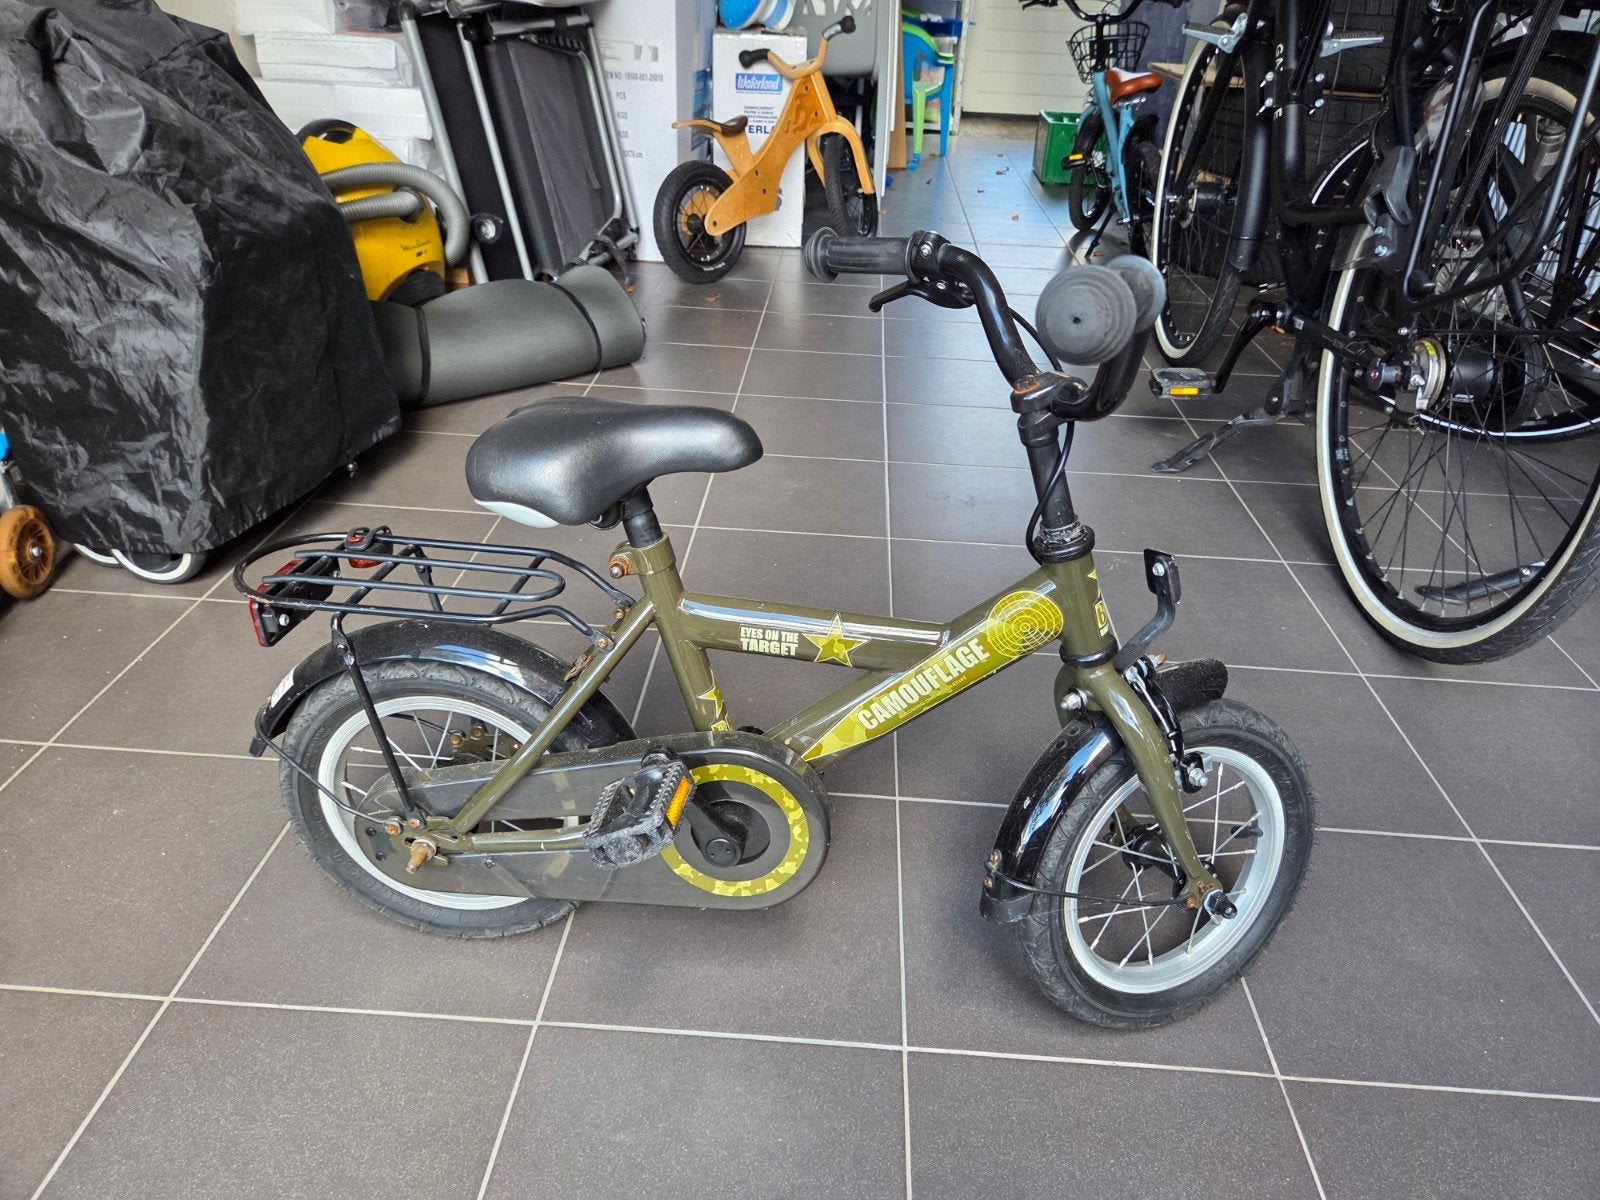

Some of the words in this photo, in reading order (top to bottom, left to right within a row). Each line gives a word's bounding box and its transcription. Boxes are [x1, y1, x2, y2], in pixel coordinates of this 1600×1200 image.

[736, 75, 781, 91] Waterland
[740, 626, 764, 639] EYES
[764, 629, 779, 641] ON
[780, 631, 799, 644] THE
[740, 637, 799, 656] TARGET
[857, 637, 991, 730] CAMOUFLAGE
